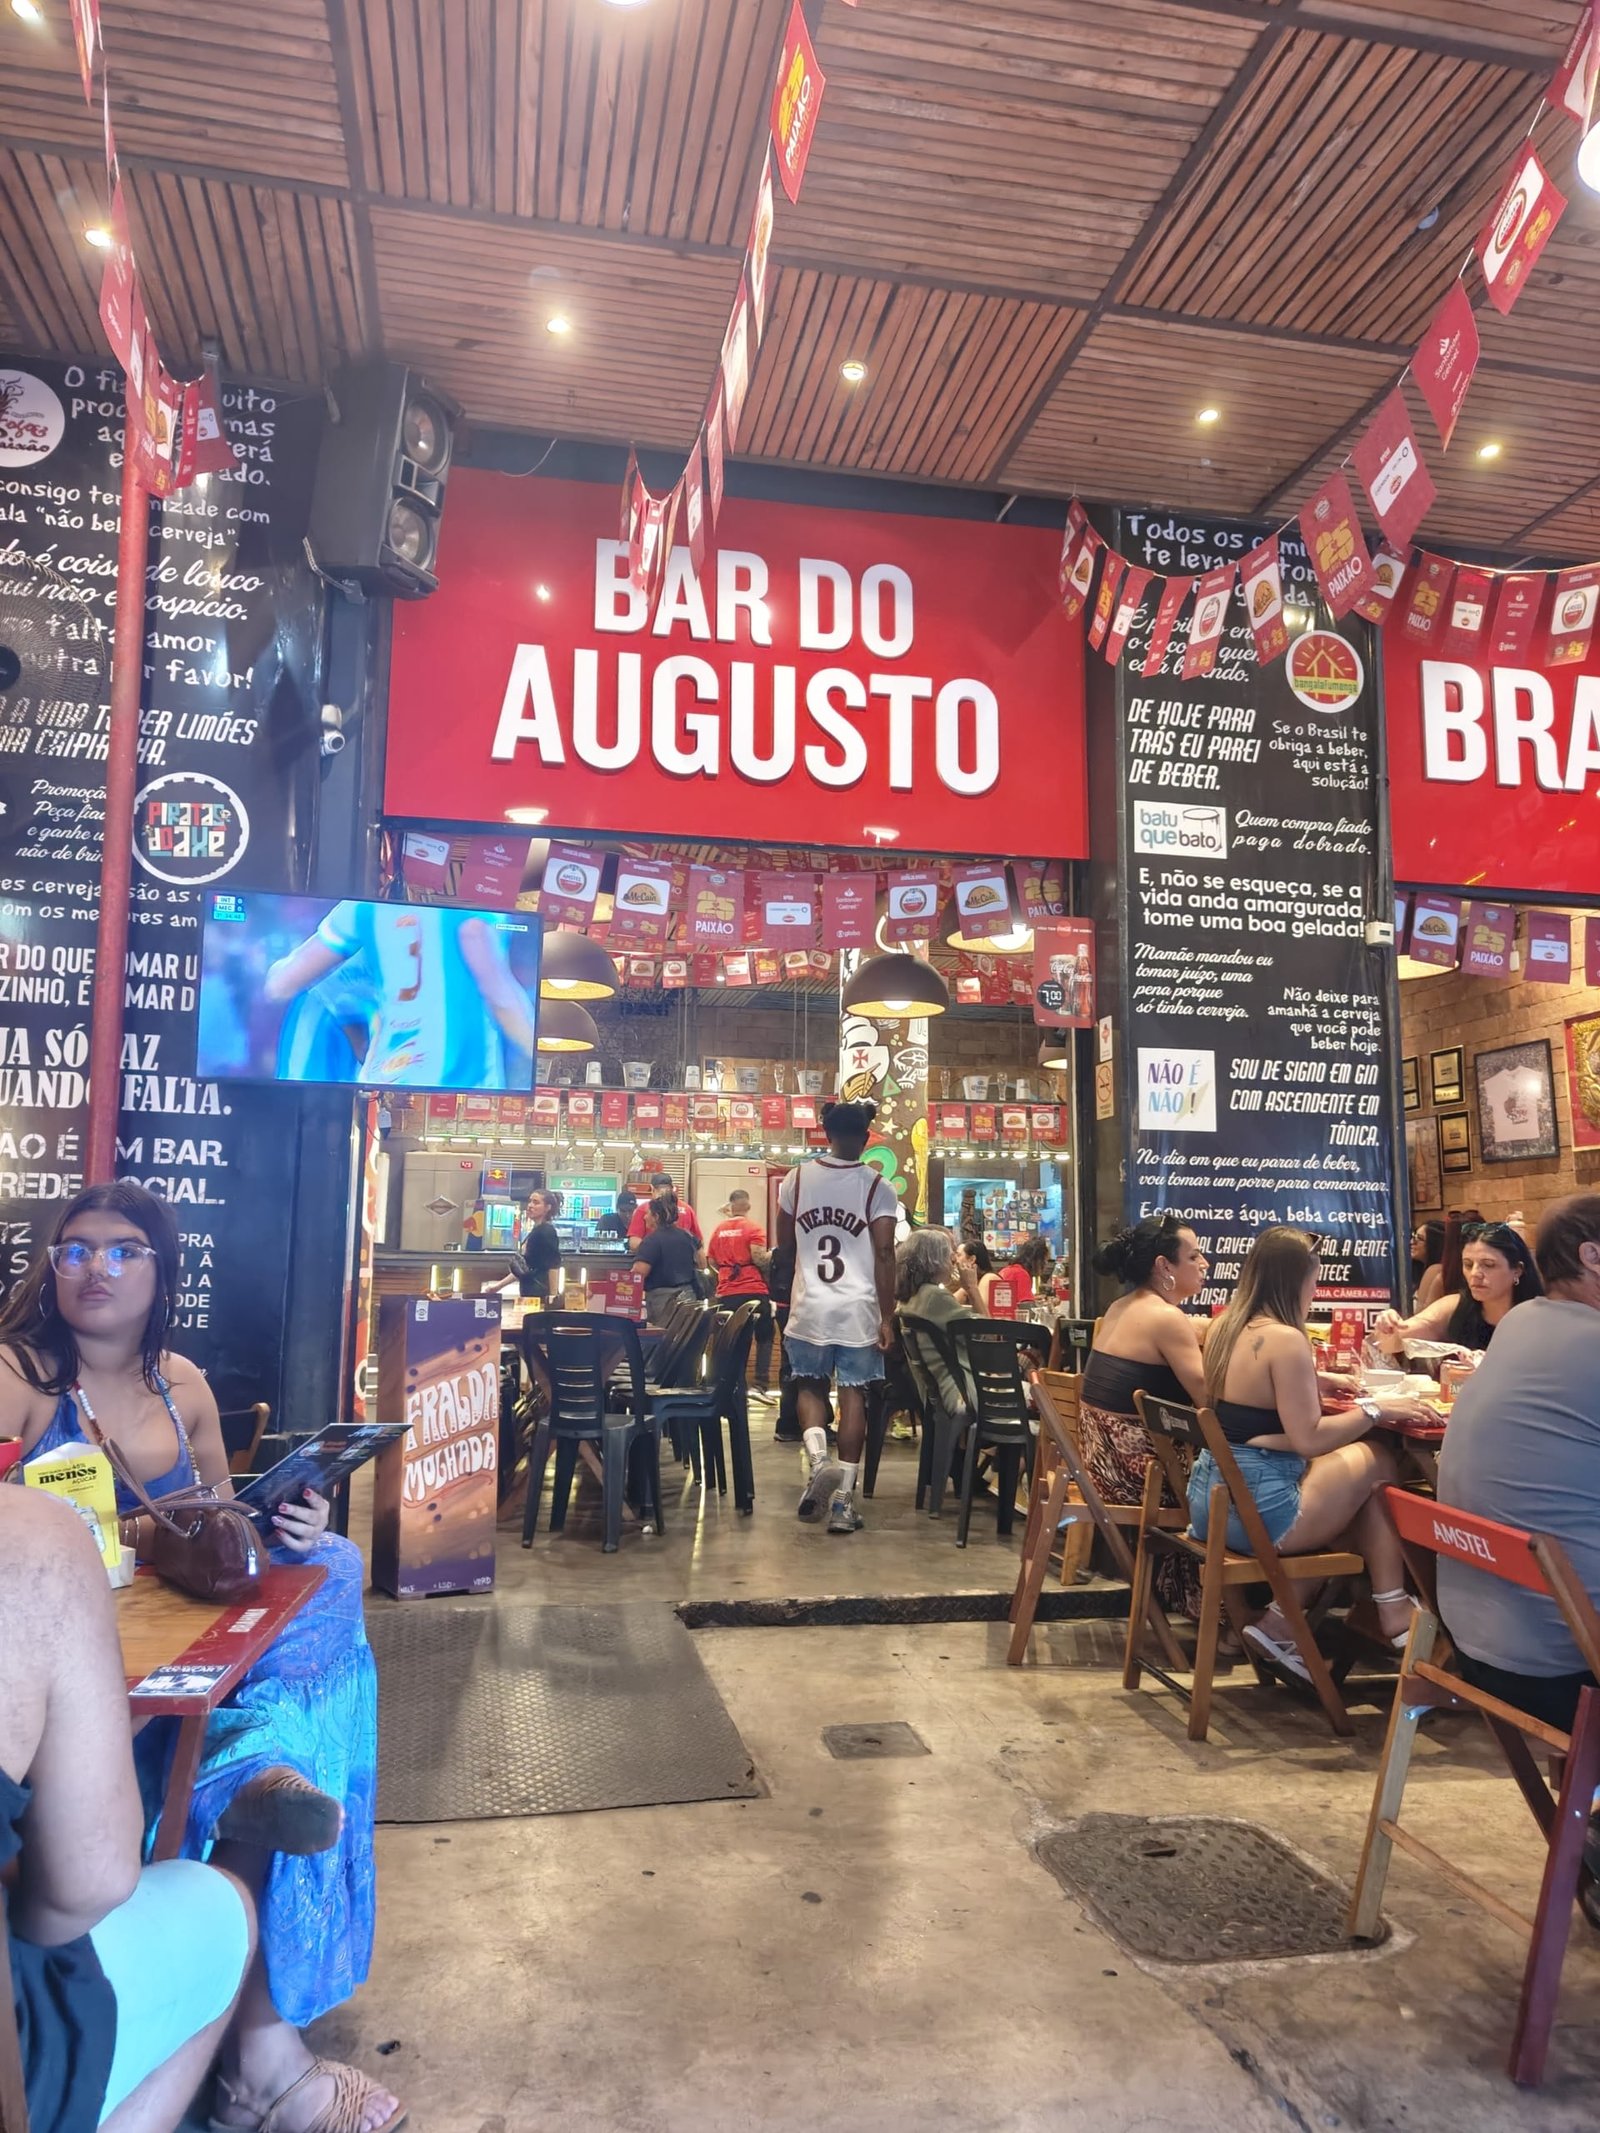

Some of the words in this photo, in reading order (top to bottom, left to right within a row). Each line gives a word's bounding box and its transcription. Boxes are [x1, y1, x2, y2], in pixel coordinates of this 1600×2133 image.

[785, 74, 810, 169] PAIXÃO
[226, 508, 270, 524] com
[1127, 515, 1204, 543] Todos
[1214, 532, 1243, 547] os
[145, 556, 178, 583] de
[184, 560, 264, 592] louco
[1328, 556, 1362, 598] PAIXÃO
[37, 578, 101, 603] não
[594, 539, 773, 646] BAR
[799, 556, 913, 659] DO
[166, 659, 254, 690] favor!
[491, 643, 1000, 796] AUGUSTO
[1128, 699, 1154, 722] DE
[1157, 700, 1205, 727] HOJE
[1208, 707, 1255, 733] PARA
[1272, 721, 1289, 734] Se
[1295, 726, 1303, 735] o
[1309, 724, 1347, 739] Brasil
[1352, 727, 1367, 740] te
[1130, 726, 1177, 754] TRÁS
[1180, 733, 1203, 758] EU
[1208, 736, 1261, 762] PAREI
[1269, 740, 1311, 757] obriga
[1316, 744, 1323, 754] a
[1328, 740, 1368, 758] beber,
[1129, 759, 1155, 783] DE
[1159, 761, 1221, 790] BEBER.
[1293, 758, 1320, 771] aqui
[1324, 758, 1357, 773] está
[1361, 764, 1368, 774] a
[1312, 775, 1368, 790] solução!
[33, 800, 76, 822] Peça
[1140, 809, 1178, 826] batu
[1235, 809, 1280, 828] Quem
[1282, 818, 1333, 837] compra
[1333, 817, 1373, 836] fiado
[27, 826, 37, 835] e
[38, 824, 91, 841] ganhe
[1232, 835, 1282, 850] paga
[1294, 835, 1371, 854] dobrado.
[15, 843, 51, 858] não
[51, 844, 73, 860] de
[1139, 868, 1154, 886] E,
[1161, 869, 1198, 886] não
[1204, 875, 1224, 889] se
[1230, 877, 1316, 898] esqueça,
[1322, 883, 1343, 897] se
[1349, 885, 1362, 898] a
[167, 890, 190, 903] as
[630, 890, 657, 902] McCain
[1139, 889, 1182, 907] vida
[1188, 892, 1238, 910] anda
[1244, 898, 1366, 919] amargurada,
[39, 905, 65, 919] os
[1144, 910, 1194, 927] tome
[1201, 914, 1242, 930] uma
[1248, 915, 1286, 933] boa
[1291, 919, 1364, 937] gelada!
[695, 919, 734, 935] PAIXÃO
[15, 944, 45, 971] DO
[51, 947, 96, 977] QUE
[1134, 942, 1194, 961] Mamãe
[1196, 949, 1254, 965] mandou
[1256, 955, 1273, 966] eu
[1470, 951, 1503, 966] PAIXÃO
[1136, 965, 1179, 979] tomar
[1180, 965, 1219, 984] juízo,
[1221, 970, 1253, 983] uma
[78, 976, 92, 1005] É
[1133, 986, 1172, 998] pena
[1172, 987, 1223, 1000] porque
[1284, 987, 1311, 1001] Não
[1316, 989, 1349, 1004] deixe
[1353, 994, 1380, 1006] para
[1136, 996, 1153, 1013] só
[1156, 999, 1193, 1015] tinha
[1196, 1006, 1248, 1021] cerveja.
[1268, 1004, 1316, 1018] amanhã
[1322, 1009, 1329, 1018] a
[1334, 1007, 1380, 1023] cerveja
[1290, 1023, 1311, 1034] que
[1316, 1021, 1348, 1034] você
[1351, 1021, 1381, 1036] pode
[44, 1023, 89, 1068] SÓ
[1311, 1036, 1346, 1050] beber
[1351, 1038, 1381, 1054] hoje.
[1148, 1060, 1184, 1084] NÃO
[1190, 1060, 1201, 1085] É
[1230, 1058, 1257, 1081] SOU
[1262, 1060, 1282, 1081] DE
[1284, 1061, 1325, 1083] SIGNO
[1330, 1063, 1350, 1084] EM
[1355, 1064, 1378, 1084] GIN
[1148, 1088, 1183, 1113] NÃO
[1230, 1089, 1261, 1111] COM
[1265, 1091, 1355, 1114] ASCENDENTE
[1358, 1094, 1380, 1115] EM
[1329, 1121, 1379, 1146] TÔNICA.
[56, 1127, 80, 1161] É
[153, 1137, 228, 1167] BAR.
[1136, 1148, 1159, 1166] No
[1161, 1149, 1186, 1166] dia
[1190, 1155, 1209, 1166] em
[1213, 1155, 1239, 1170] que
[1241, 1157, 1257, 1167] eu
[1258, 1157, 1301, 1170] parar
[1303, 1154, 1320, 1169] de
[1323, 1156, 1360, 1172] beber,
[0, 1172, 83, 1200] REDE
[1139, 1173, 1165, 1185] vou
[1168, 1173, 1210, 1187] tomar
[1213, 1178, 1235, 1187] um
[1236, 1178, 1275, 1191] porre
[1275, 1179, 1310, 1192] para
[1313, 1180, 1389, 1192] comemorar.
[796, 1206, 869, 1237] IVERSON
[1240, 1204, 1281, 1226] água,
[1286, 1207, 1322, 1223] beba
[1328, 1210, 1388, 1228] cerveja.
[817, 1234, 845, 1283] 3
[1315, 1288, 1331, 1298] SUA
[1333, 1287, 1369, 1299] CÂMERA
[406, 1362, 498, 1452] FRALDA
[39, 1466, 97, 1484] menos
[1433, 1520, 1496, 1562] AMSTEL
